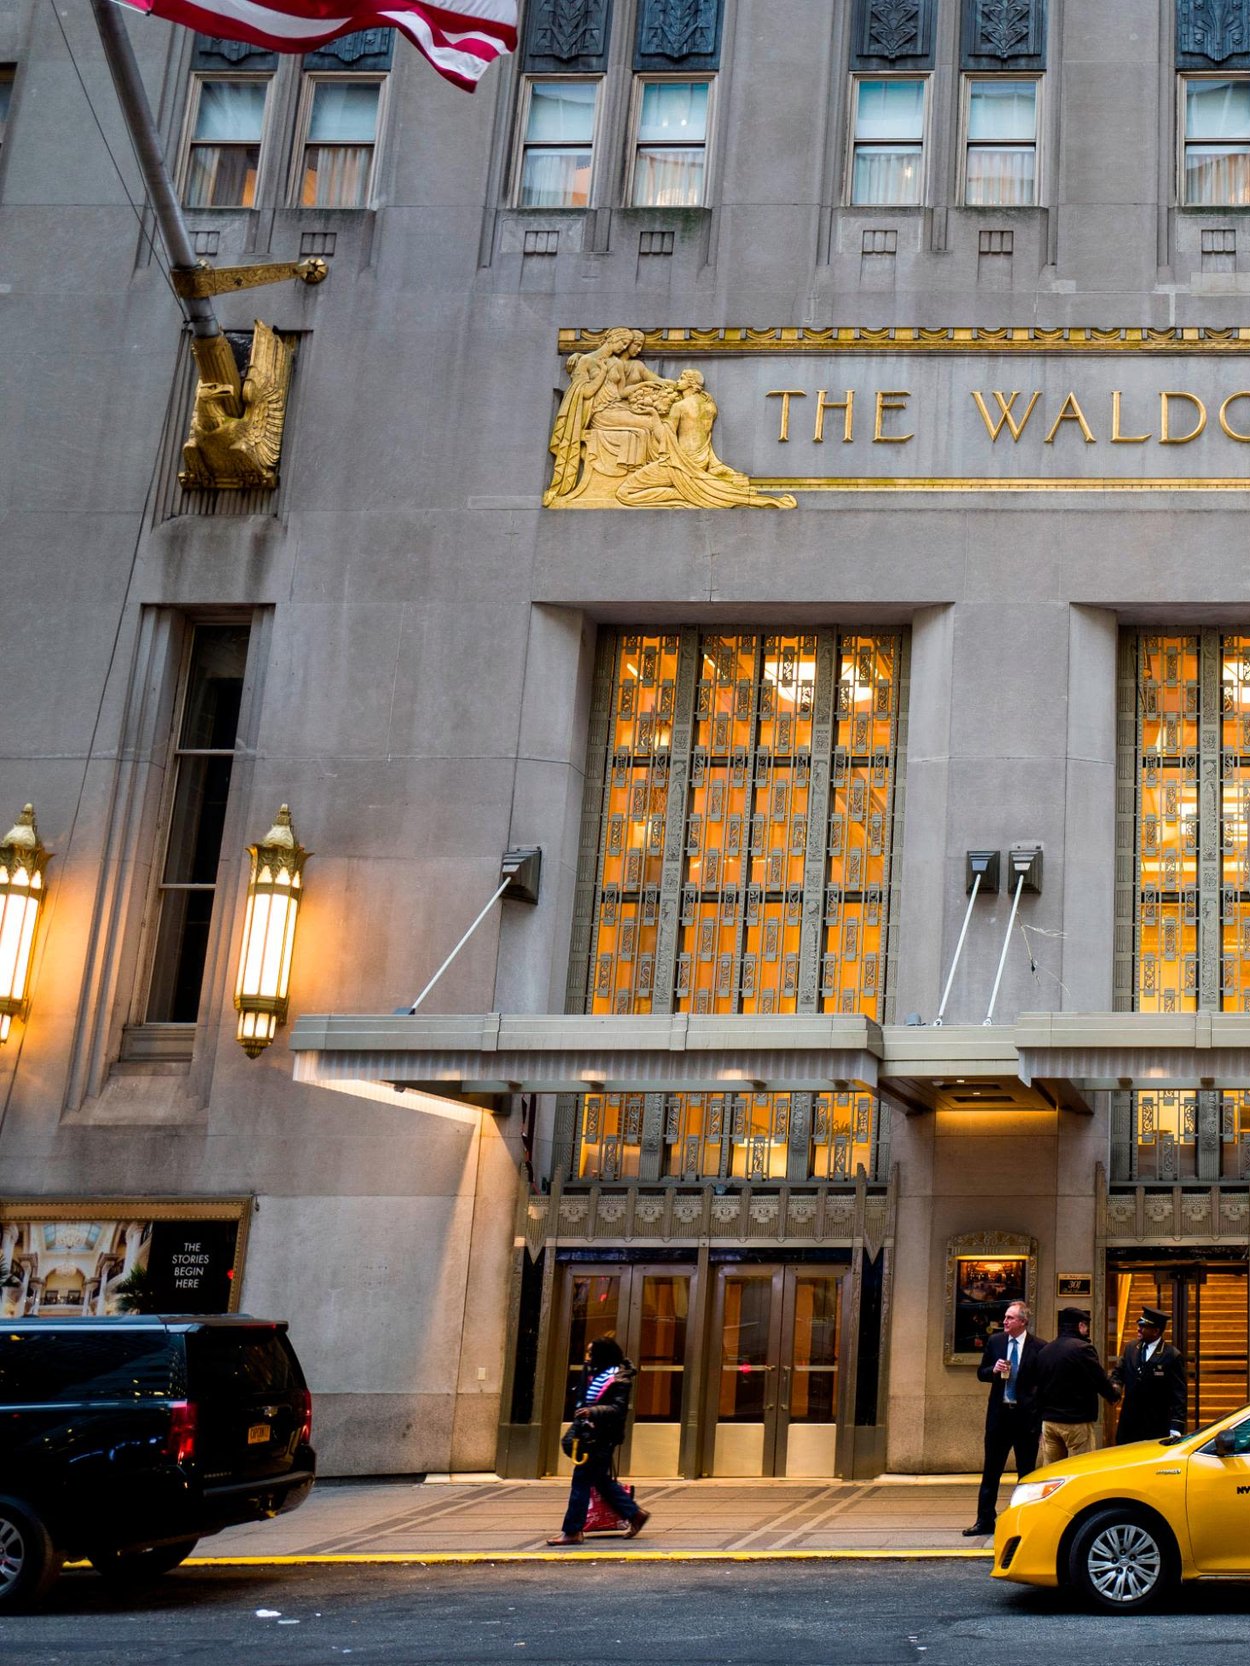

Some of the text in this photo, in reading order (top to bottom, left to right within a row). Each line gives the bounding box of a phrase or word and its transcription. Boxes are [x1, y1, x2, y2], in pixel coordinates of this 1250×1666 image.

[766, 390, 914, 443] THE
[184, 1242, 201, 1252] THE
[172, 1254, 209, 1264] STORIES
[174, 1266, 204, 1276] BEGIN
[175, 1279, 199, 1288] HERE
